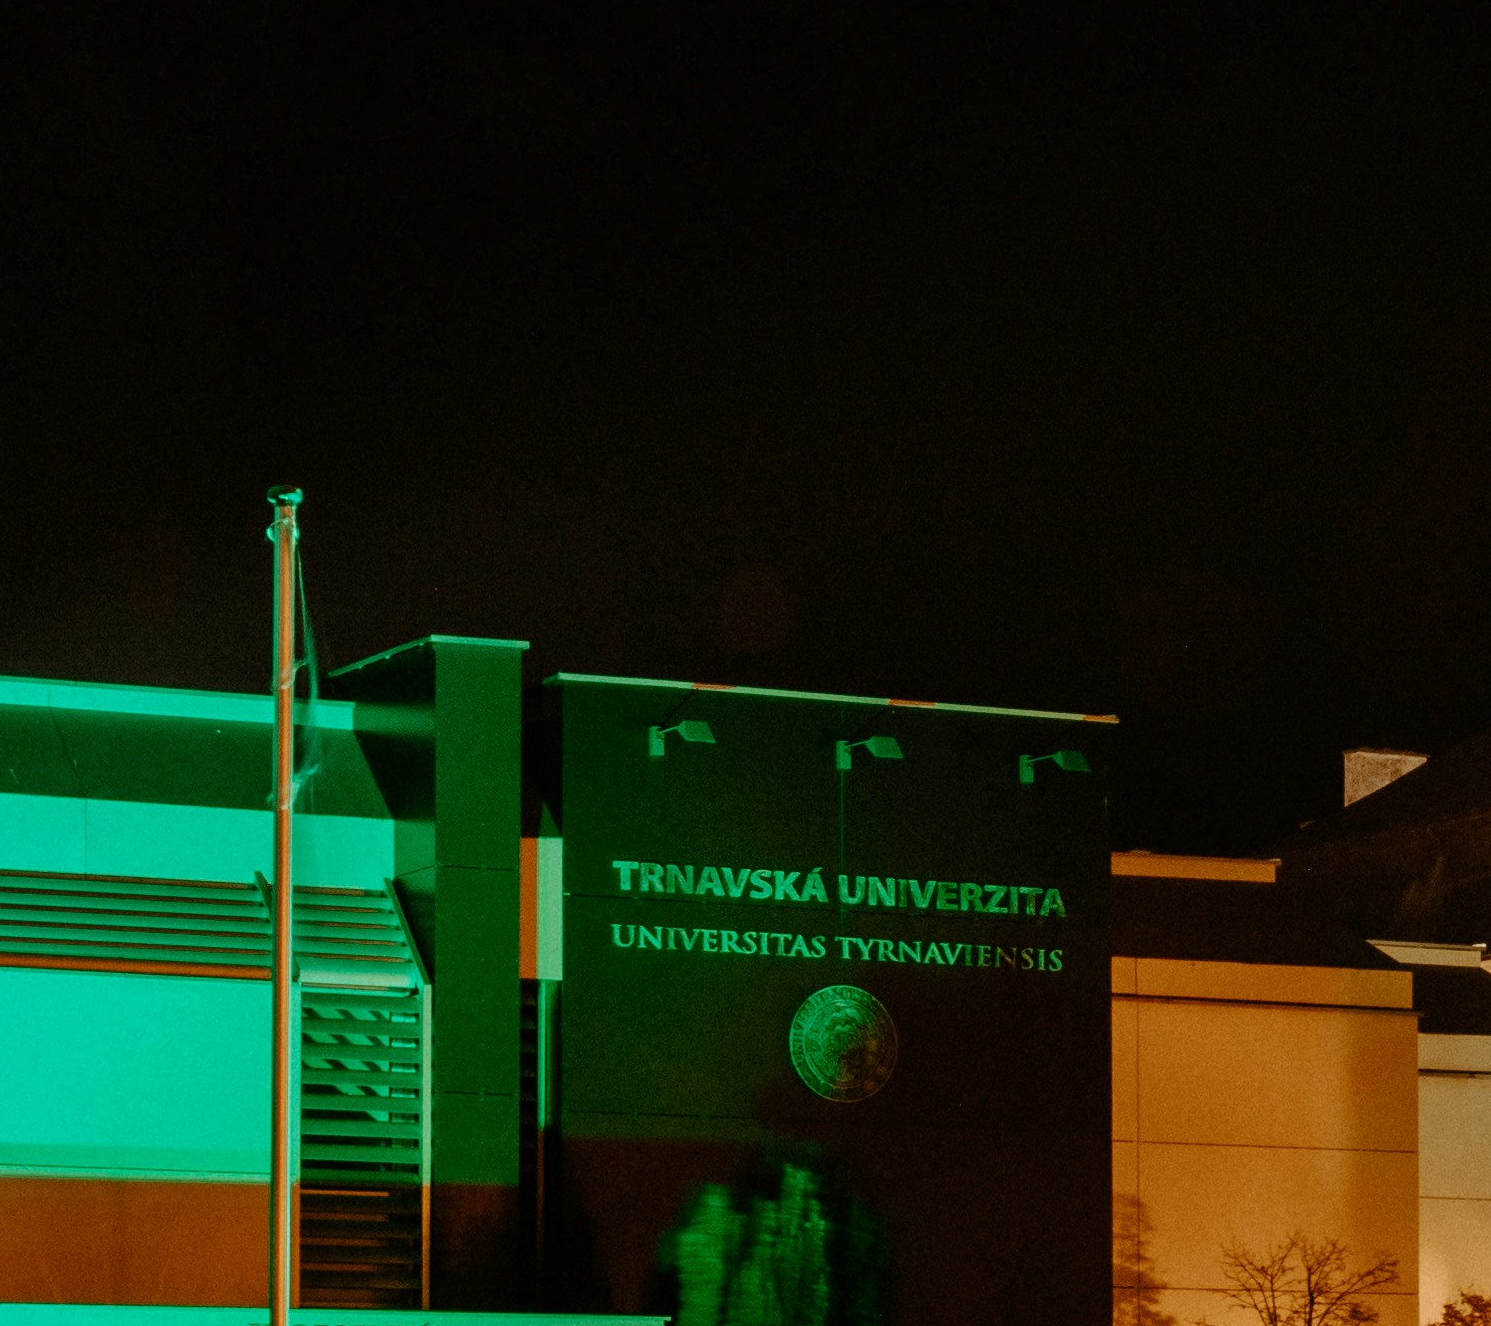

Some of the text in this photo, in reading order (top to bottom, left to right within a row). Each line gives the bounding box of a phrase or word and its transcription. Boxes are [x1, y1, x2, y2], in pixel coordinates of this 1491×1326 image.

[611, 860, 1067, 919] TRNAVSKÁ UNIVERZITA
[610, 923, 1064, 973] UNIVERSITAS TYRNAVIENSIS
